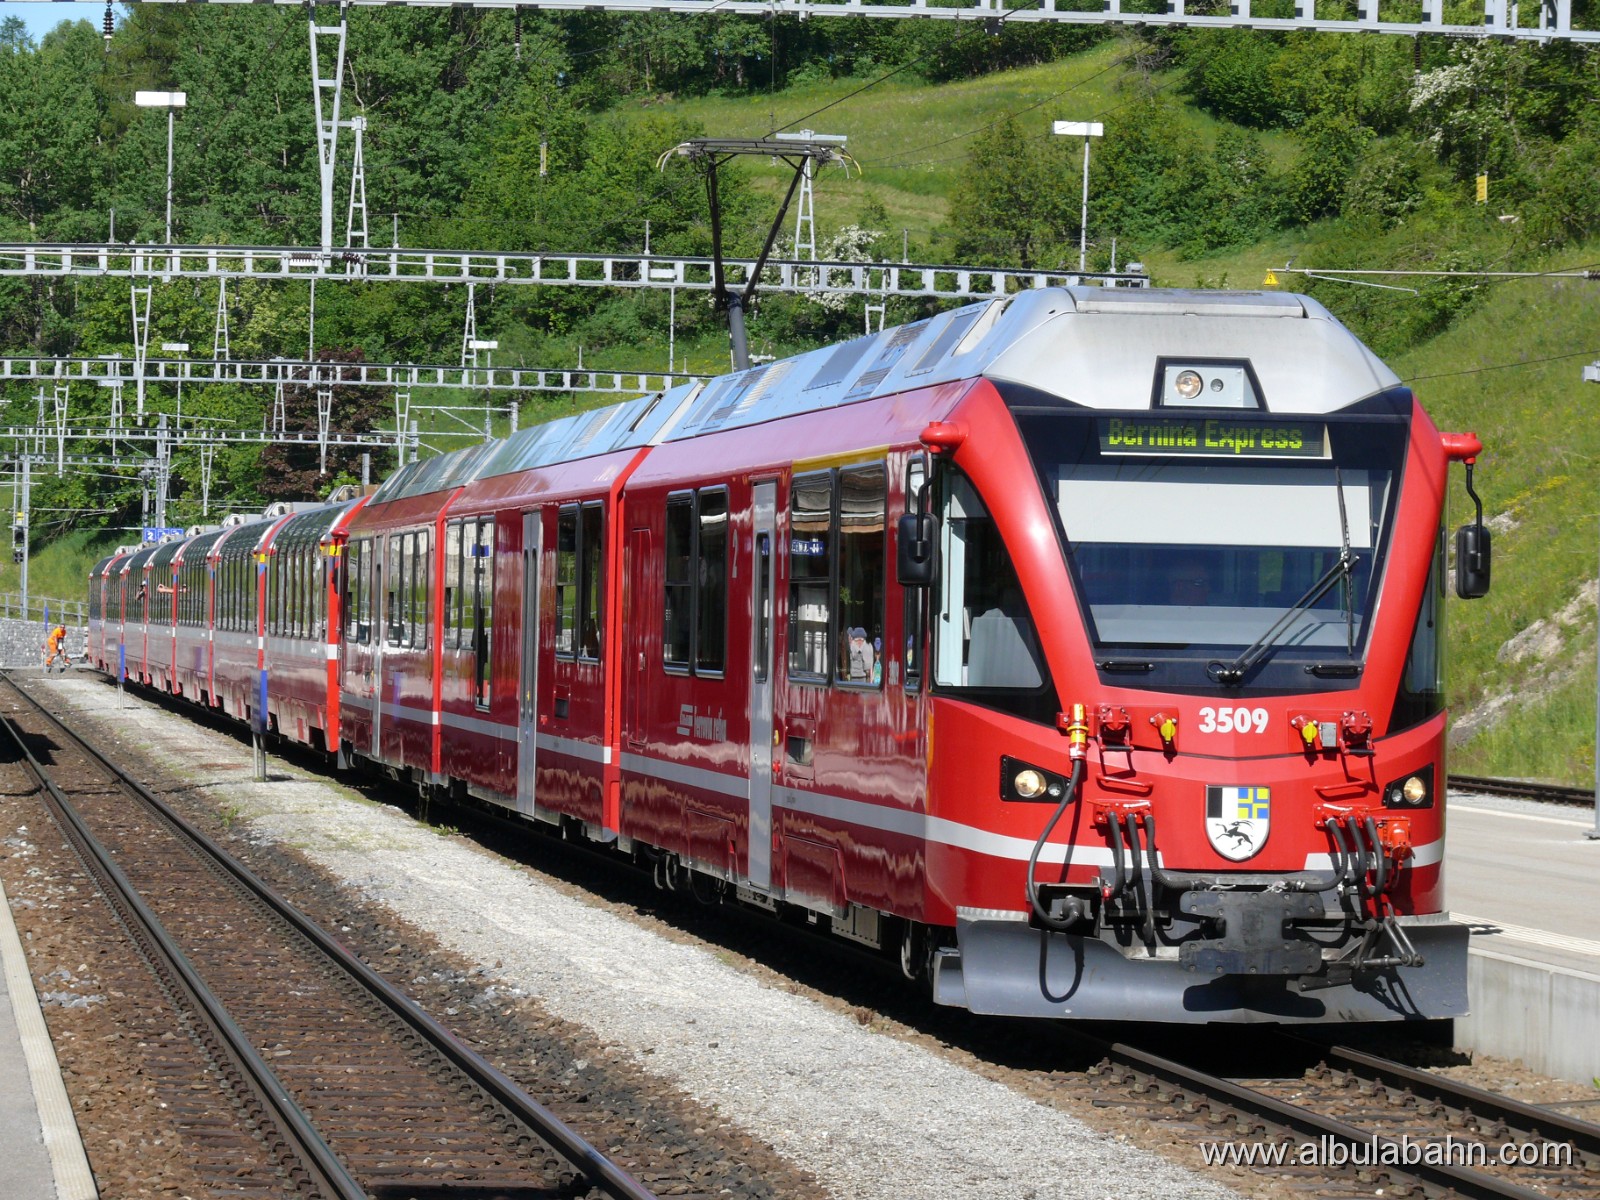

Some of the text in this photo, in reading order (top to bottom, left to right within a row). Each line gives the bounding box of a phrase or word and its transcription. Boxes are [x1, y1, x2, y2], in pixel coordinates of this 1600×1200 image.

[1108, 418, 1303, 454] Bernina Express
[731, 528, 738, 578] 2
[1198, 706, 1269, 734] 3509
